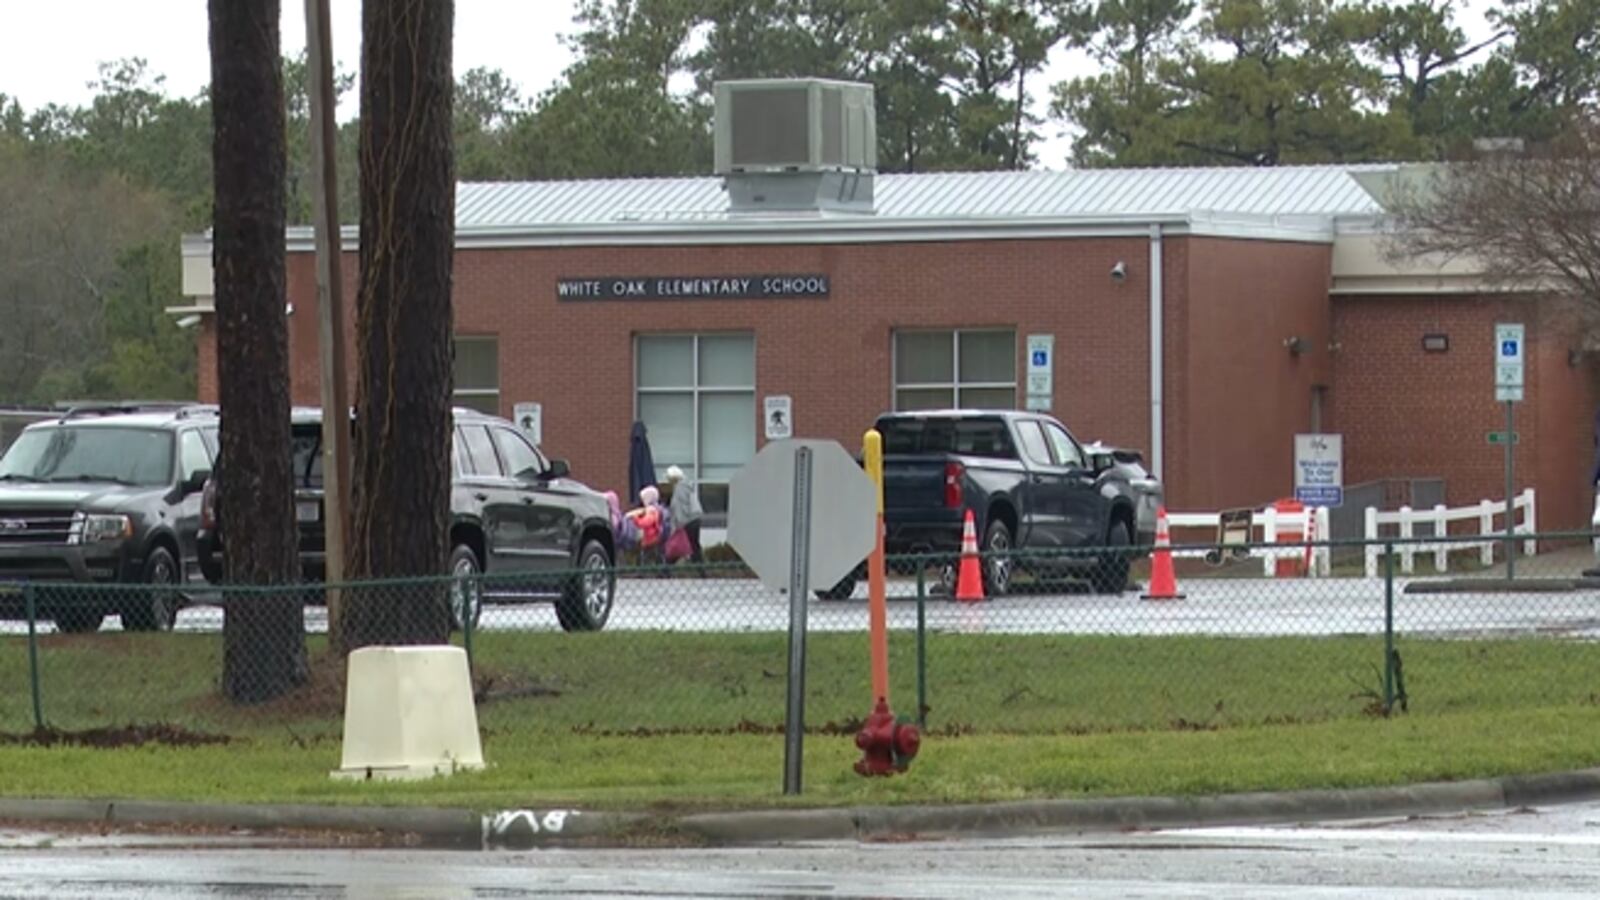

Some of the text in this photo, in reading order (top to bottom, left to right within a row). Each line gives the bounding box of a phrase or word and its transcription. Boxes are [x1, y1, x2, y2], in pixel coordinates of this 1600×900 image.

[558, 278, 828, 296] WHITE OAK ELEMENTARY SCHOOL
